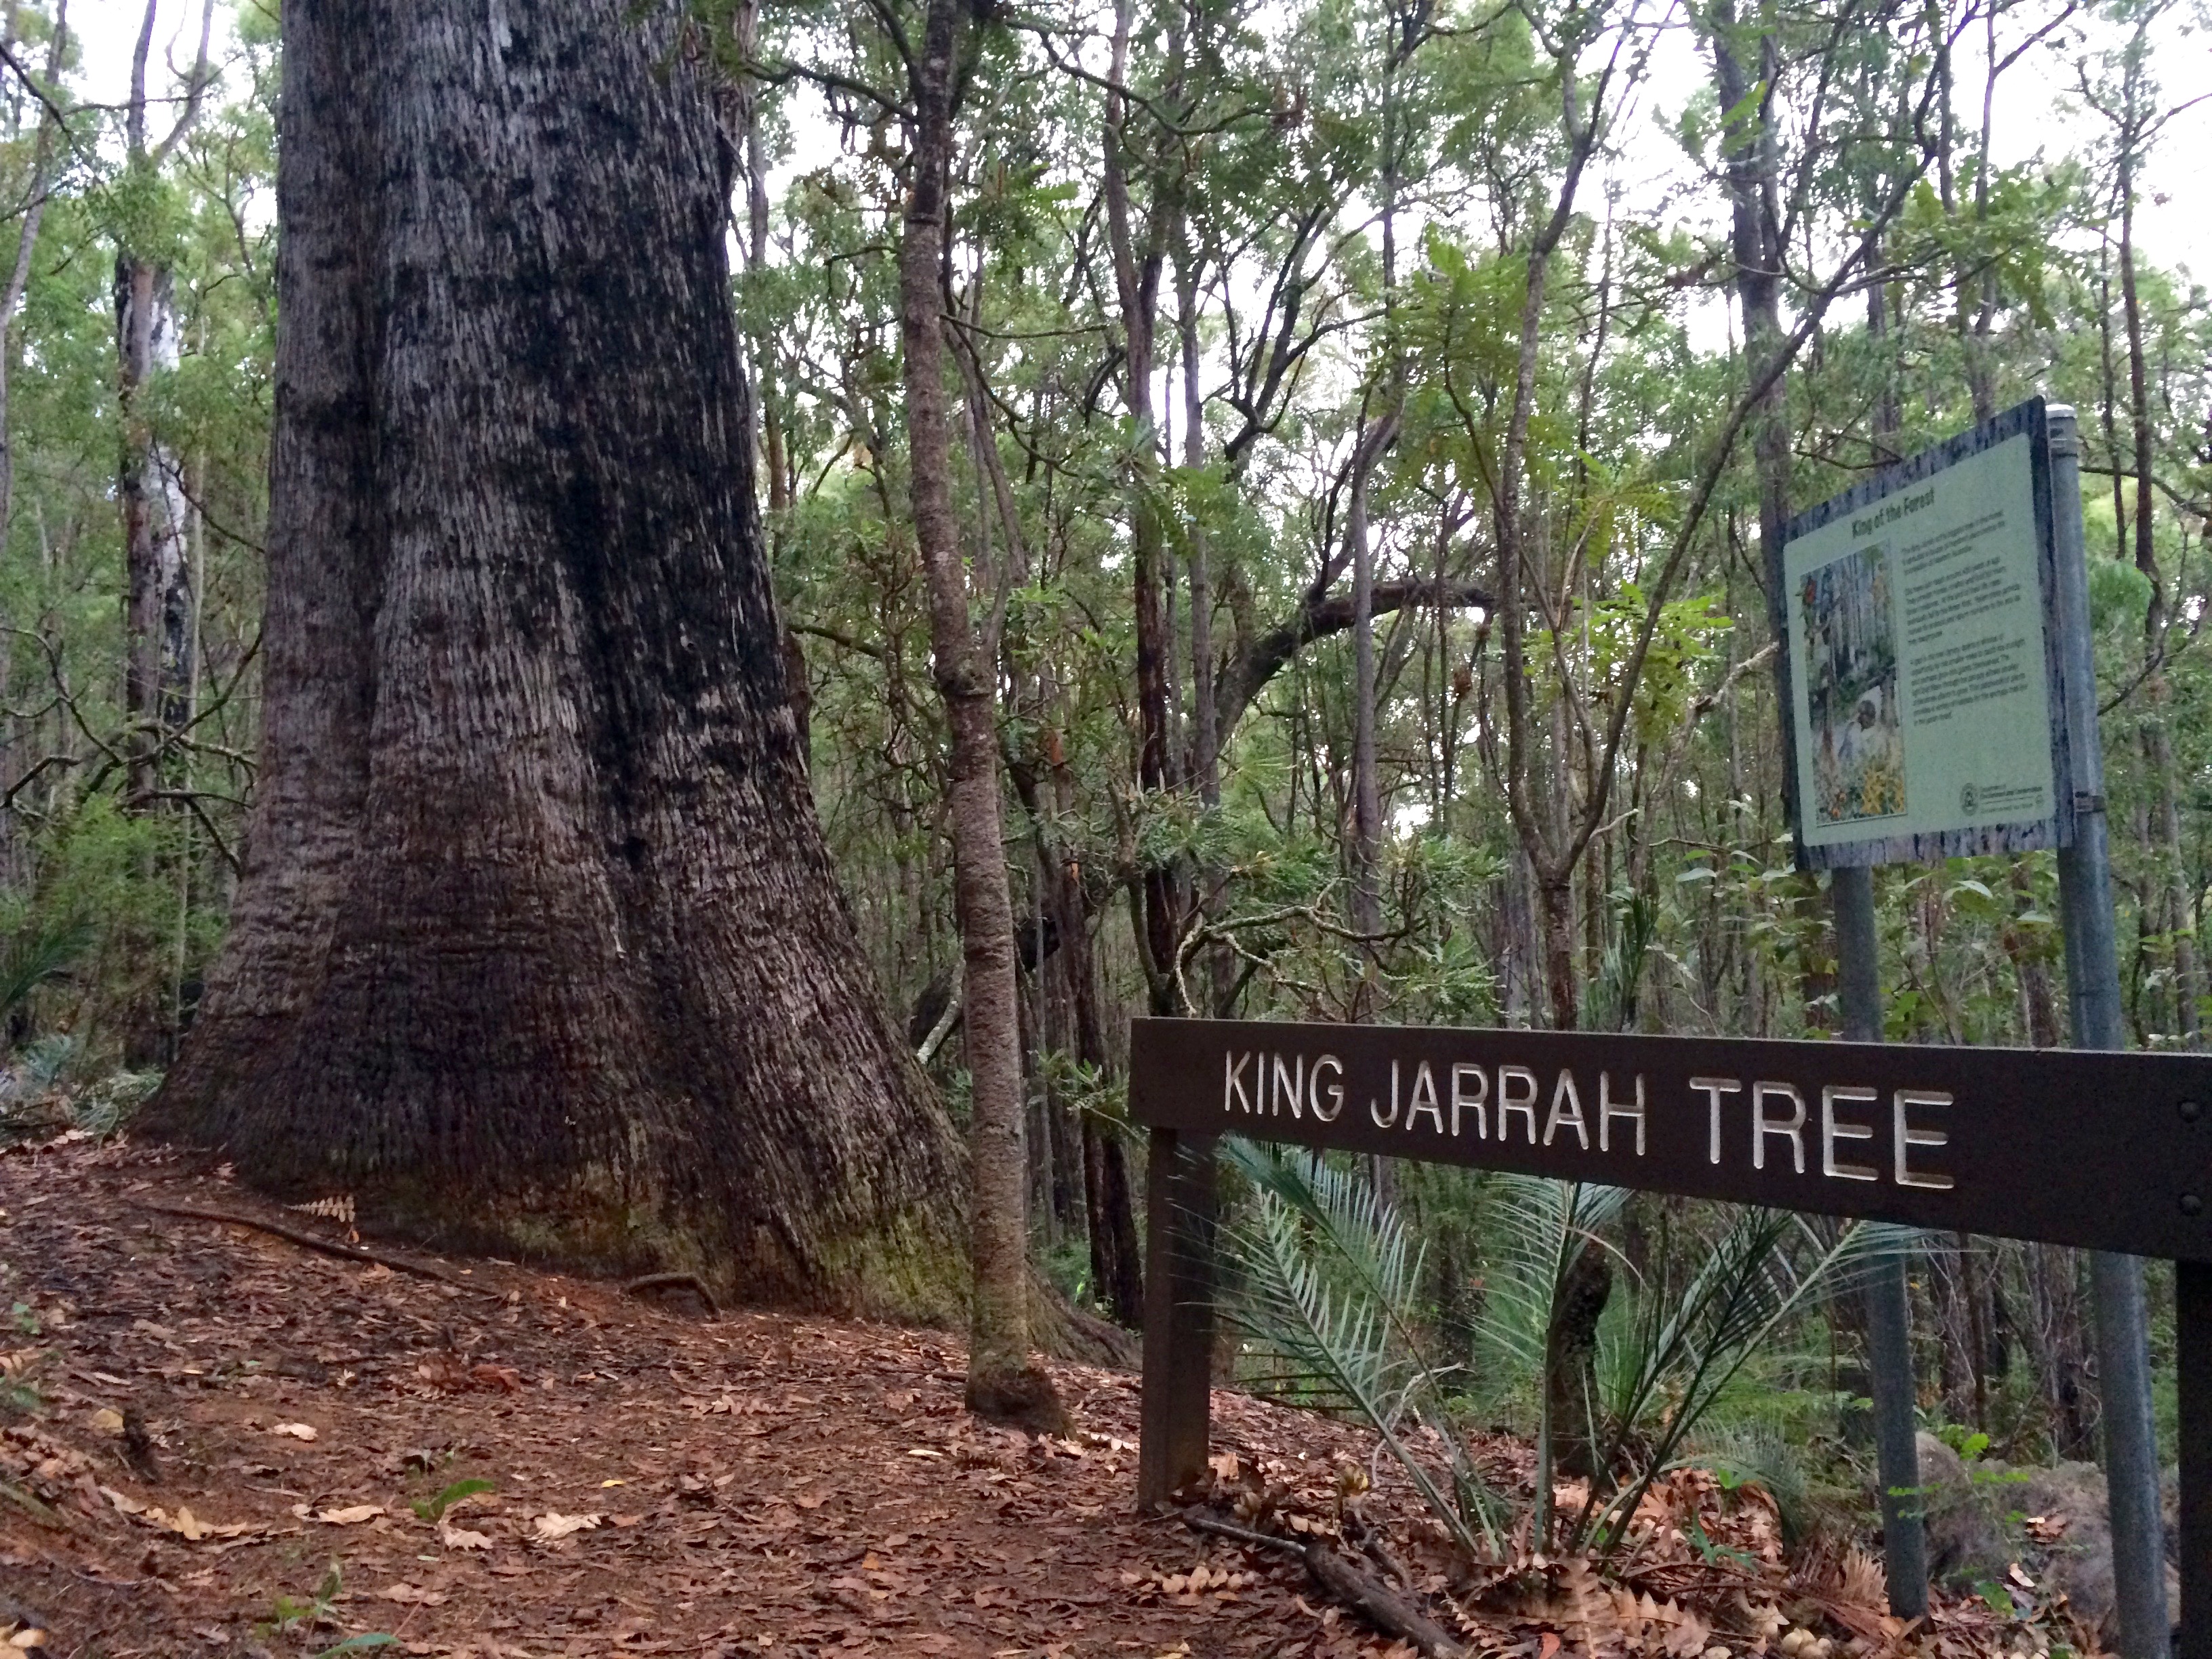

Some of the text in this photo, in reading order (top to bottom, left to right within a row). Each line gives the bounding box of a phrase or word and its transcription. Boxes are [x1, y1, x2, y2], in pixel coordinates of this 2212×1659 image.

[1852, 487, 1935, 538] King of the Forest
[1225, 1050, 1954, 1189] KING JARRAH TREE
